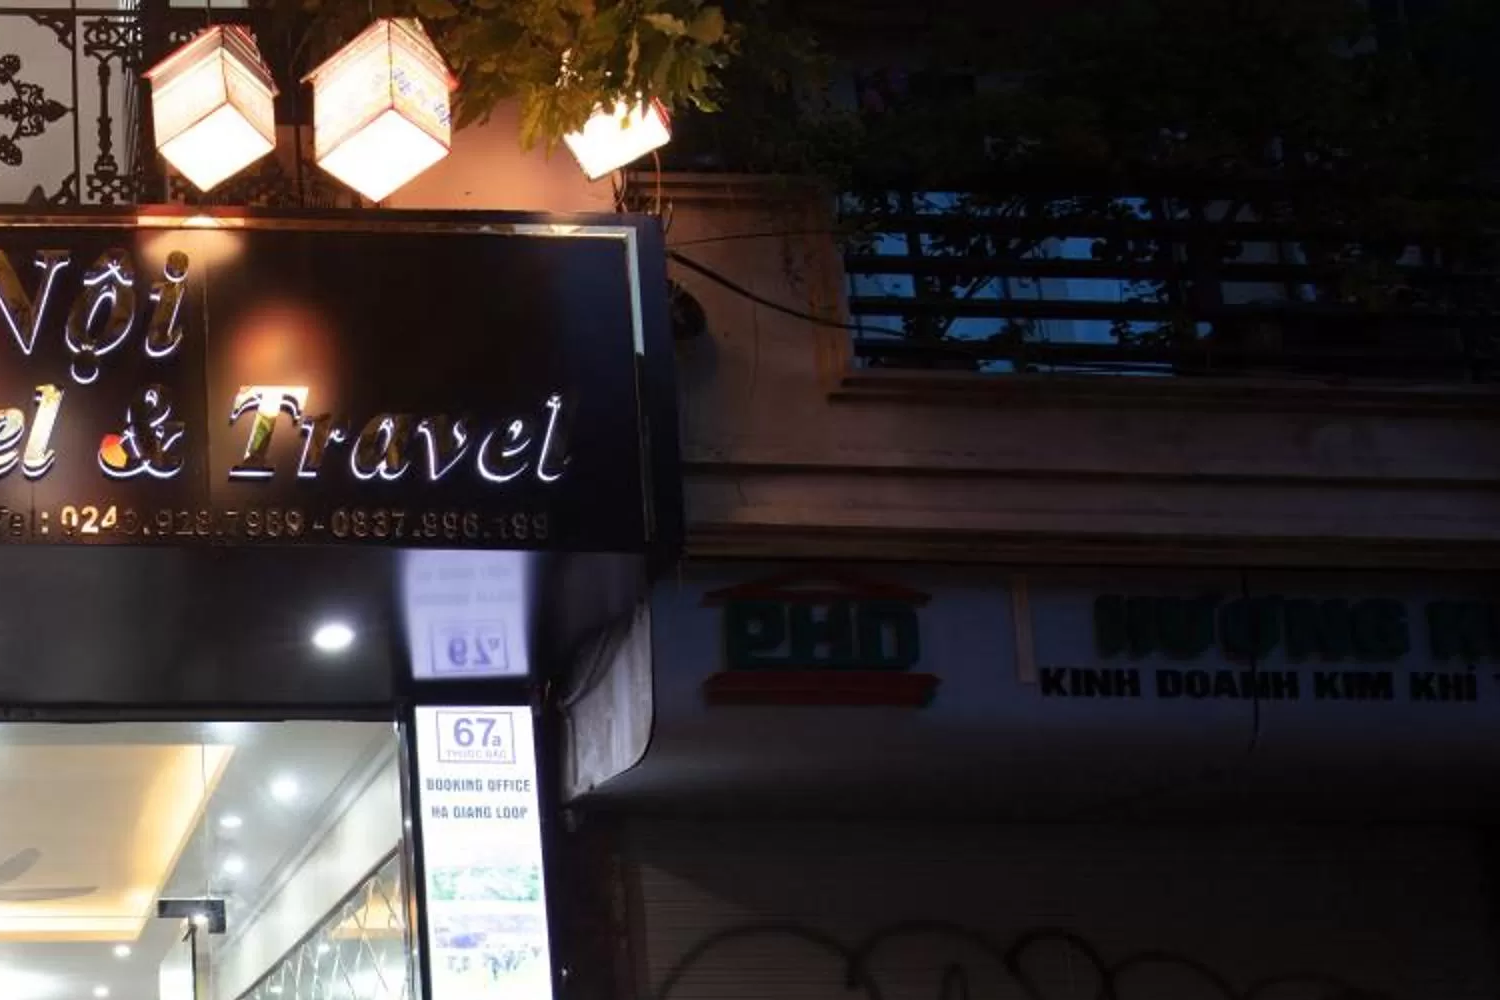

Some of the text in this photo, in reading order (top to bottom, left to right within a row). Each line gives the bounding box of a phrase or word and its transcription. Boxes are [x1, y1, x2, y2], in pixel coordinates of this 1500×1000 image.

[98, 385, 186, 480] &
[228, 385, 571, 483] Travel
[1040, 667, 1141, 698] KINH
[1156, 668, 1299, 700] DOANH
[1314, 671, 1395, 701] KIM
[452, 717, 502, 748] 67a
[426, 777, 532, 793] BOOKING OFFICE
[431, 805, 529, 820] HA GIANG LOOP
